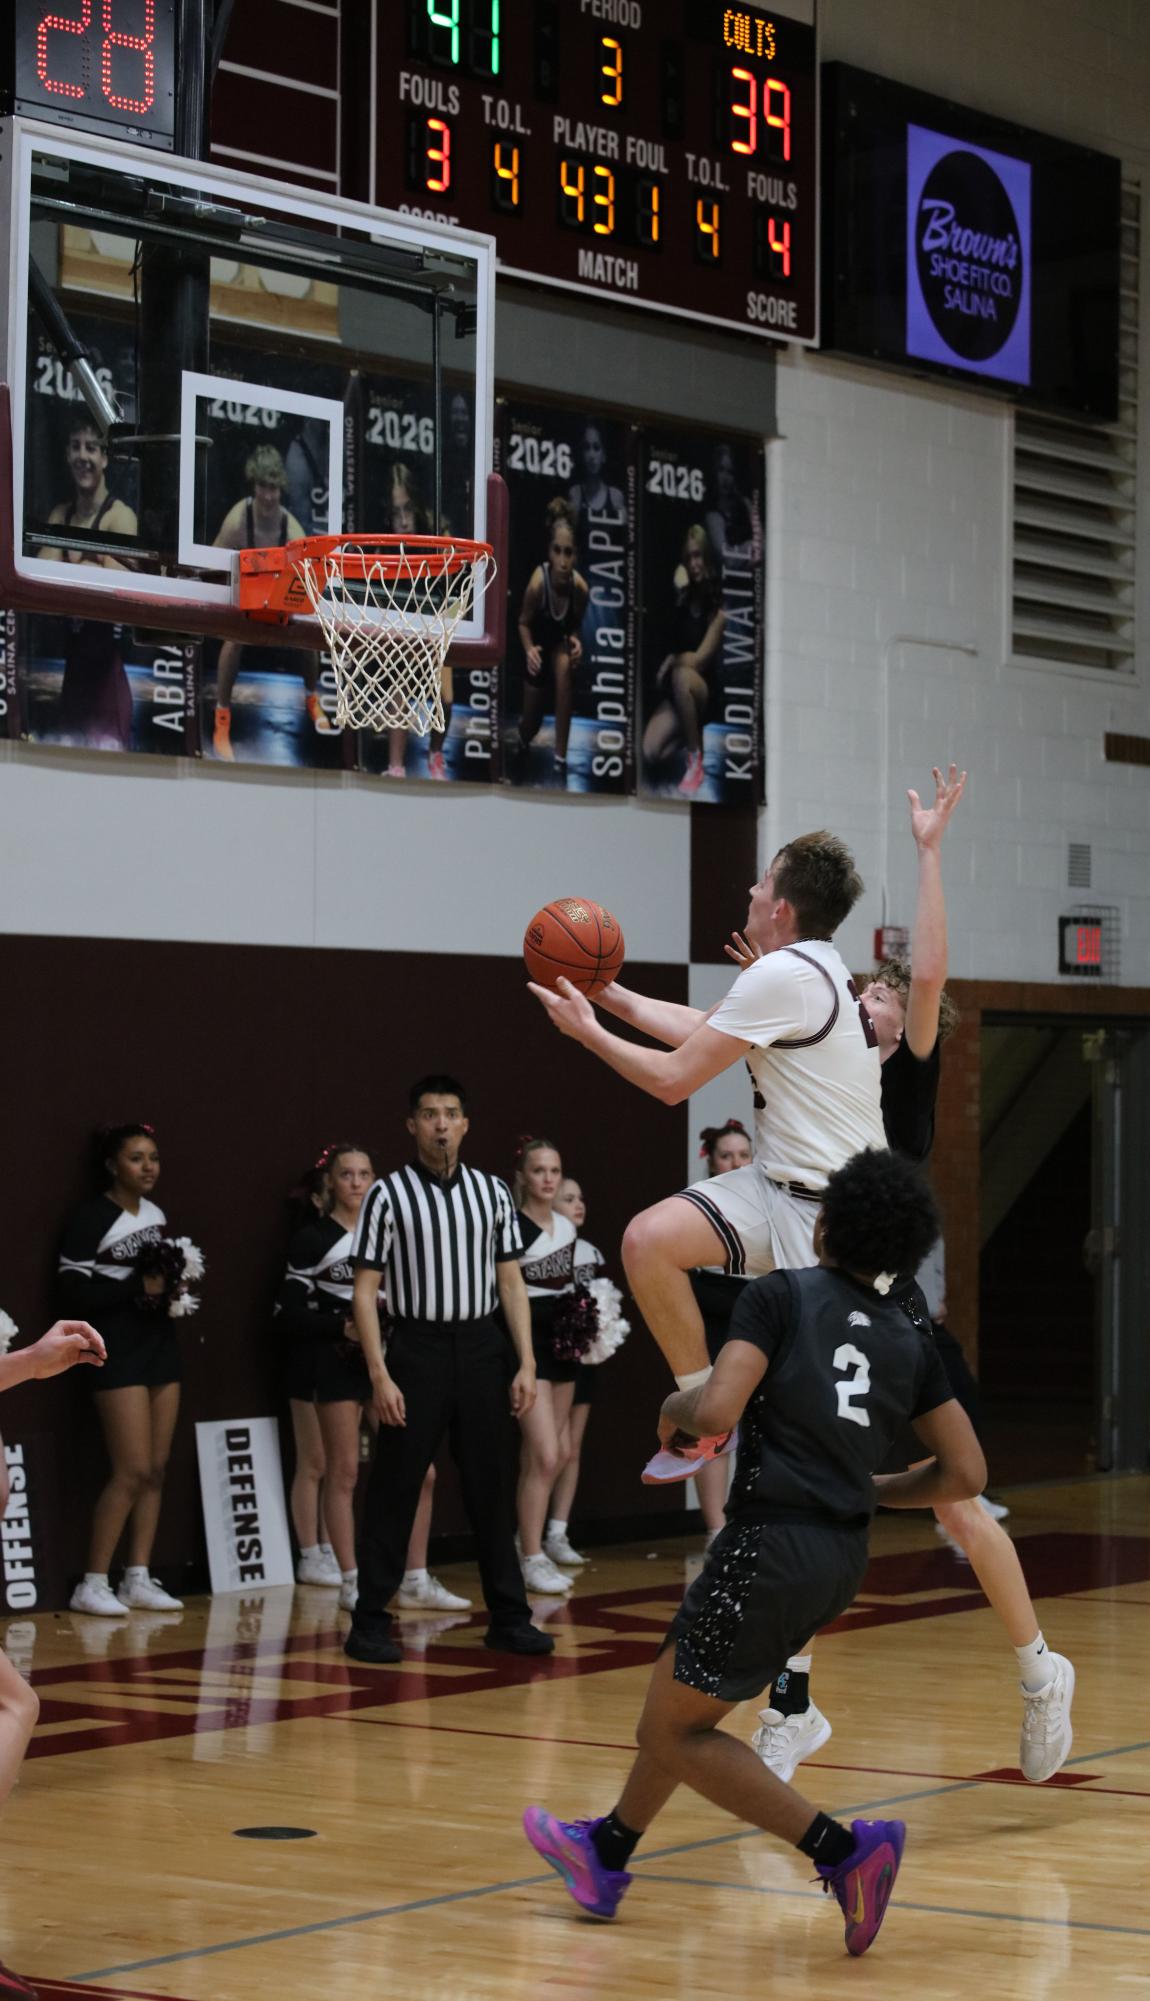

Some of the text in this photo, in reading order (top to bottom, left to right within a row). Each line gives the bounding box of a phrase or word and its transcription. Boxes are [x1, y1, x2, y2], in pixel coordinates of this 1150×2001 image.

[37, 0, 154, 114] 28
[427, 0, 499, 75] 41
[723, 9, 777, 60] COLTS
[400, 70, 460, 116] FOULS
[601, 37, 622, 106] 3
[482, 94, 532, 136] T.O.L.
[731, 66, 791, 162] 39
[426, 118, 450, 192] 3
[553, 115, 669, 174] PLAYER FOUL
[685, 153, 730, 191] T.O.L.
[494, 143, 518, 206] 4
[560, 160, 660, 242] 43 1
[747, 171, 797, 210] FOULS
[697, 199, 719, 258] 4
[768, 217, 791, 278] 4
[922, 198, 1018, 270] Brown's
[578, 249, 638, 290] MATCH
[747, 291, 797, 329] SCORE
[944, 285, 998, 323] SALINA
[34, 356, 114, 402] 206
[366, 407, 434, 454] 2026
[507, 434, 573, 479] 2026
[627, 465, 636, 543] WRESTLING
[646, 460, 706, 502] 2026
[627, 549, 636, 609] SCHOOL
[7, 641, 16, 696] SALINA
[588, 506, 625, 778] Sophia CAPE
[722, 545, 754, 781] KODI WAITE
[186, 663, 195, 717] SALINA
[626, 653, 635, 704] CENTRAL
[625, 710, 634, 766] SALINA
[833, 1343, 870, 1427] 2
[1, 1443, 37, 1609] OFFENSE
[225, 1427, 265, 1583] DEFENSE
